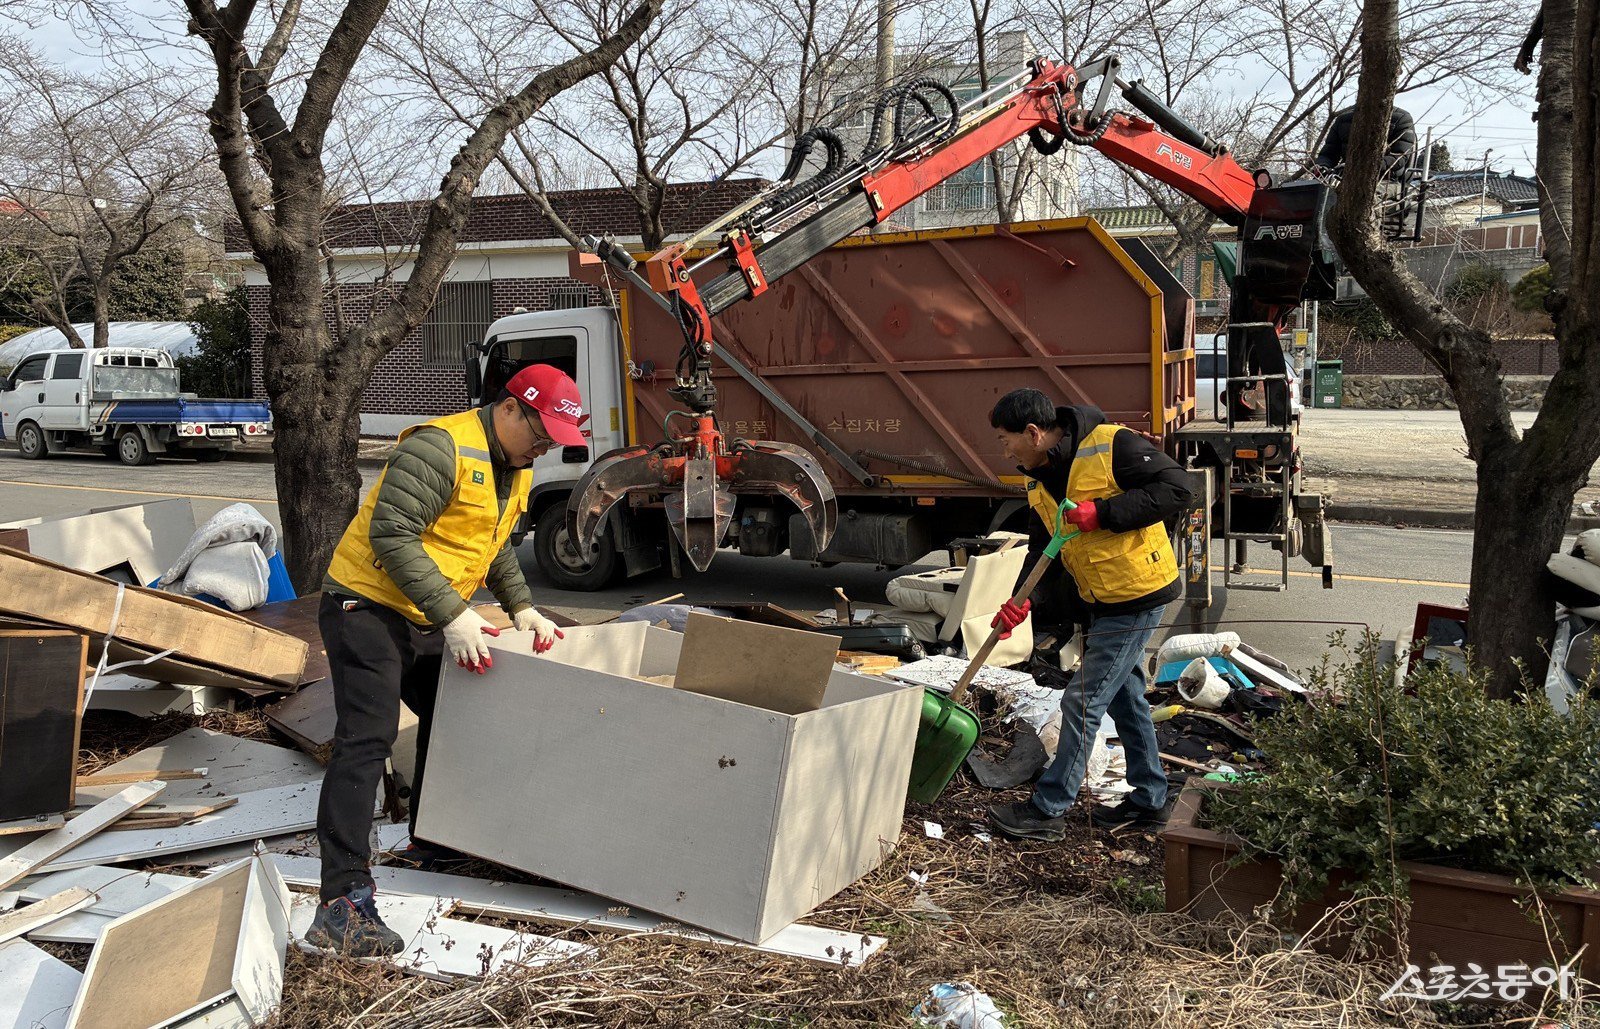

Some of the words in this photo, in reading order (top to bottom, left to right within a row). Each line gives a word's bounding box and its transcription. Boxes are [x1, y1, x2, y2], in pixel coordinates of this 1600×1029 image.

[1277, 224, 1303, 239] 광림
[523, 386, 540, 401] FJ
[827, 418, 901, 434] 수집차량
